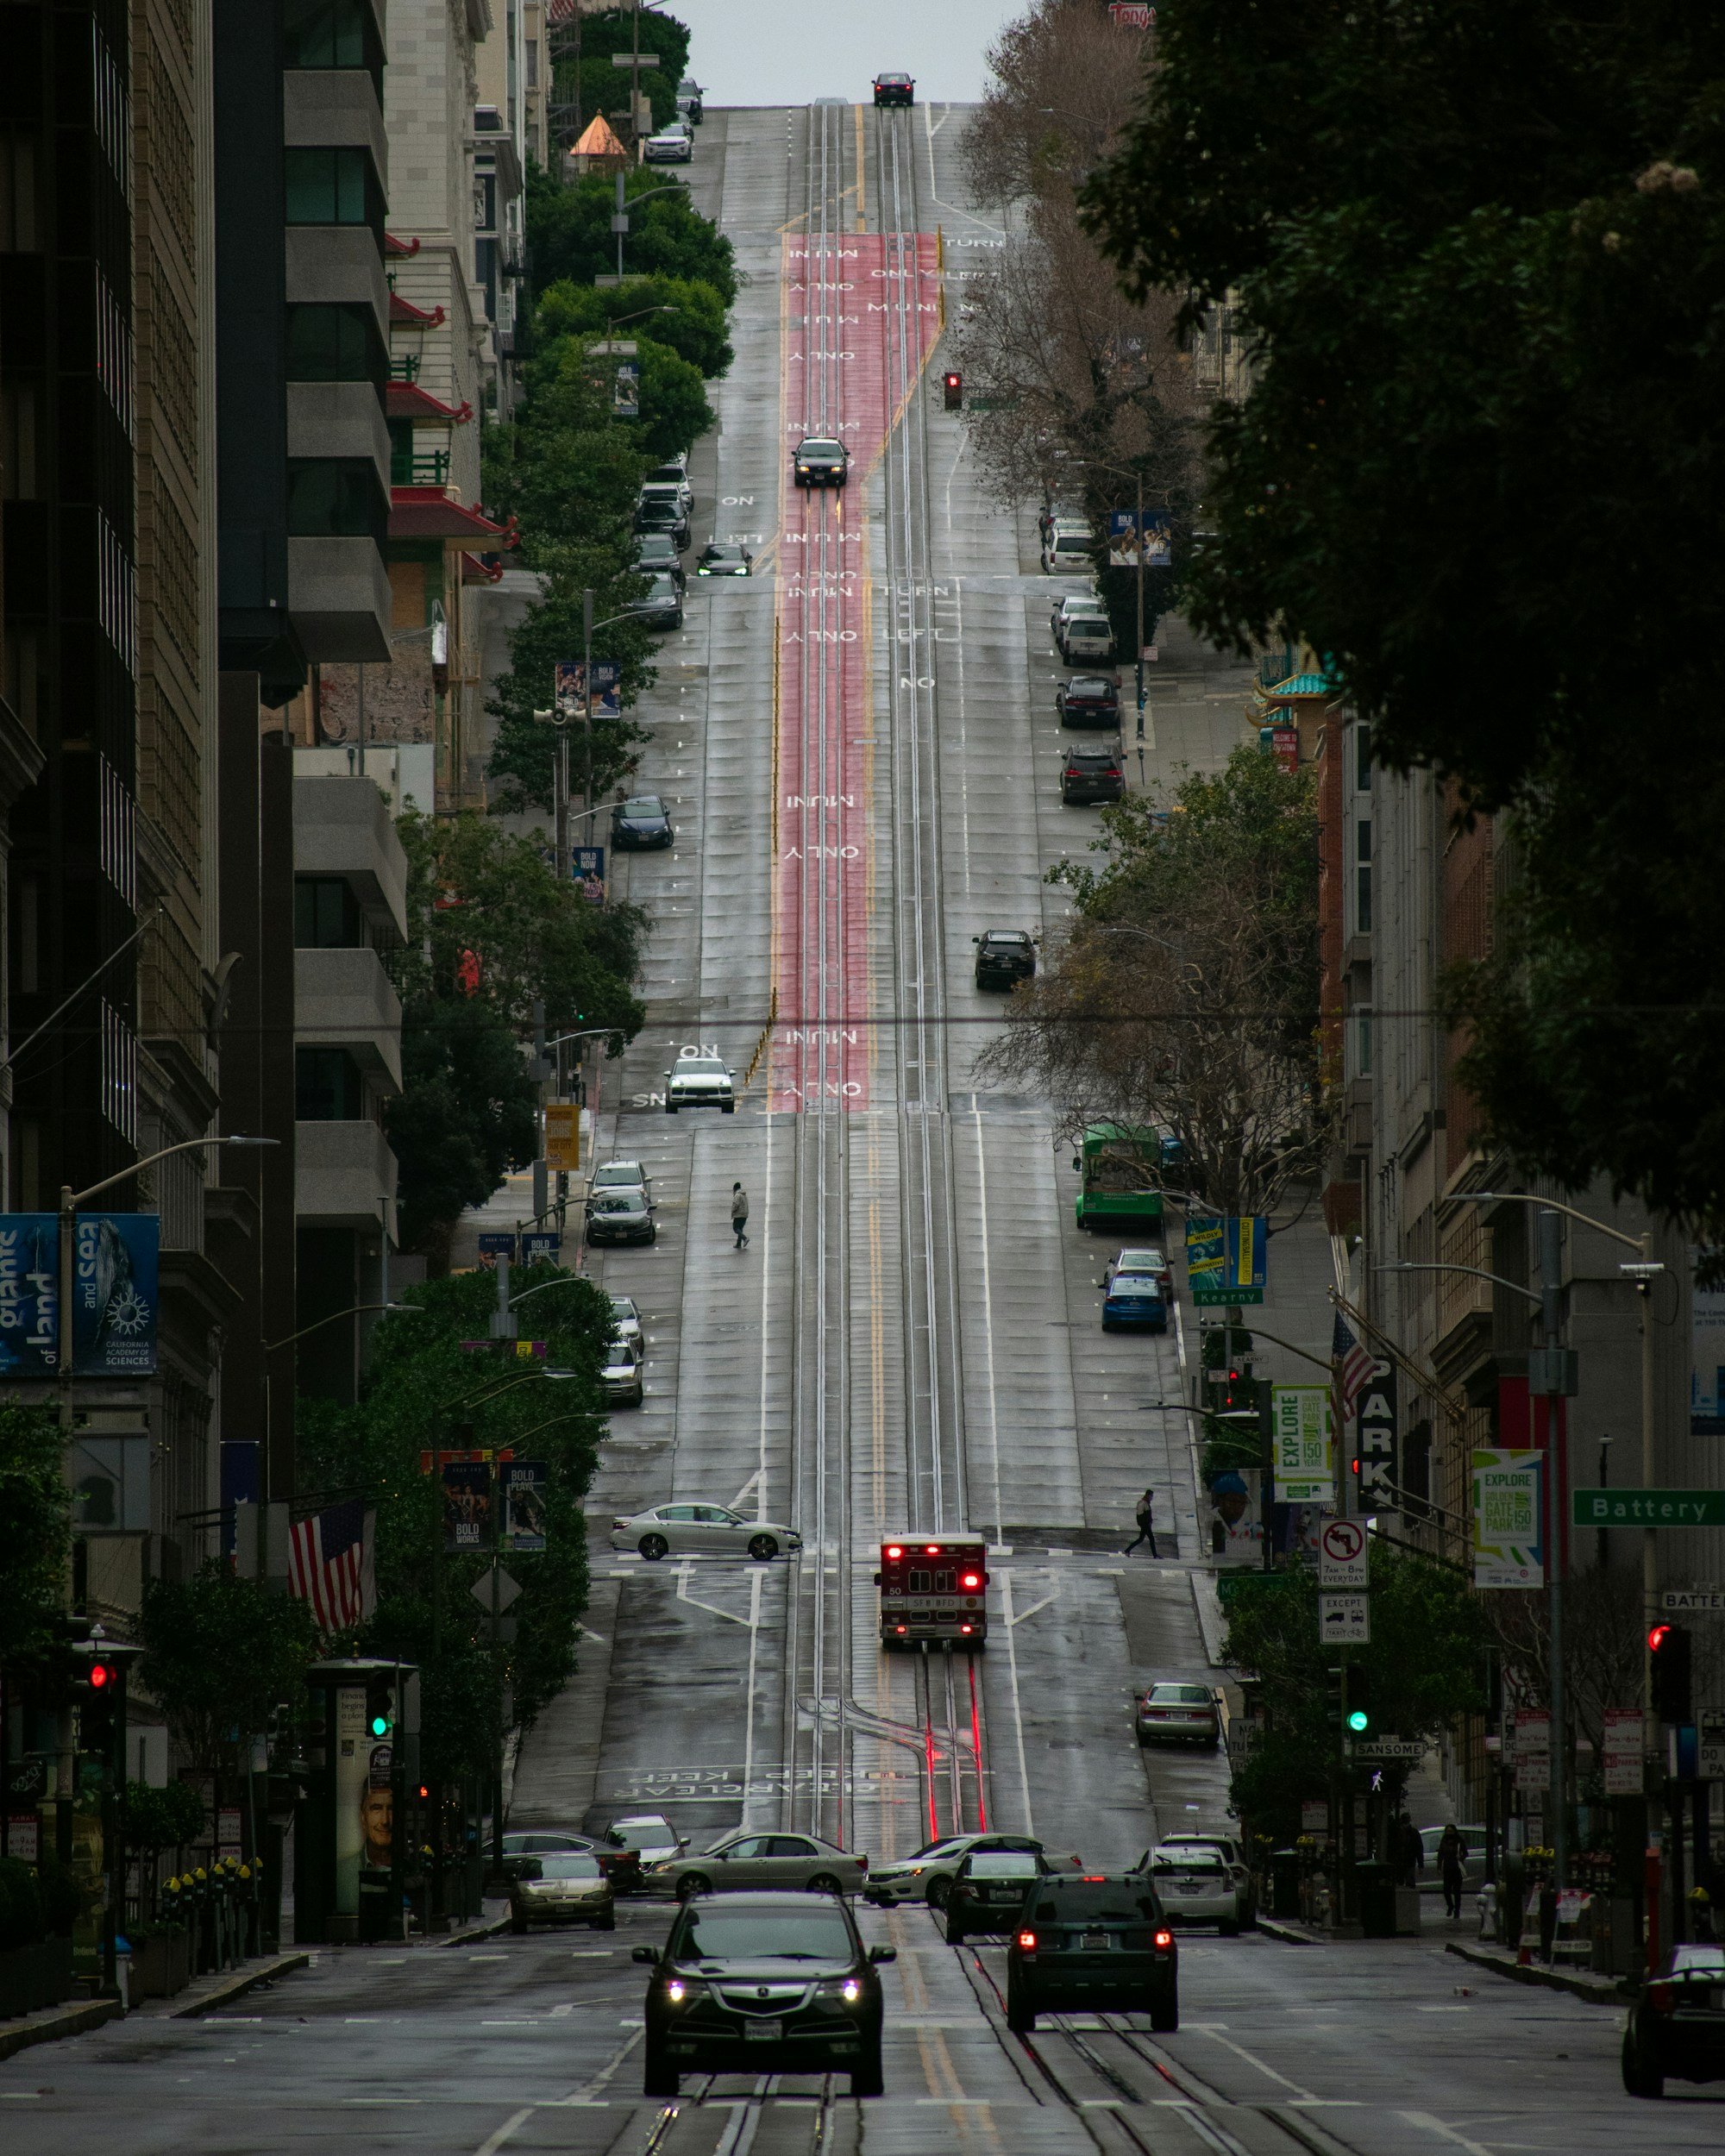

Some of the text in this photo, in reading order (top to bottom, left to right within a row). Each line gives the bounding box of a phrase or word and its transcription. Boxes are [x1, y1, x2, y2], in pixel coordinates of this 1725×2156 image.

[871, 269, 935, 278] ONLY
[868, 303, 937, 311] MUNI
[900, 677, 936, 689] NO
[1194, 1231, 1219, 1241] WILDLY
[78, 1221, 100, 1277] sea
[531, 1239, 550, 1250] BOLD
[81, 1282, 97, 1309] and
[1201, 1294, 1256, 1303] Kearny
[41, 1349, 56, 1365] of
[1362, 1358, 1394, 1487] PARK
[1282, 1395, 1300, 1467] EXPLORE
[1303, 1442, 1321, 1458] 150
[511, 1470, 535, 1482] BOLD
[1484, 1474, 1532, 1487] EXPLORE
[1485, 1502, 1514, 1517] GATE
[1592, 1498, 1708, 1521] Battery
[1515, 1510, 1532, 1525] 150
[455, 1523, 480, 1535] BOLD
[1485, 1518, 1515, 1532] PARK
[456, 1535, 480, 1544] WORKS
[889, 1587, 901, 1595] 50
[1327, 1599, 1361, 1608] EXCEPT
[1666, 1595, 1725, 1608] BATTE
[342, 1702, 365, 1711] begins
[1358, 1745, 1421, 1754] SANSOME
[1702, 1749, 1717, 1760] DO
